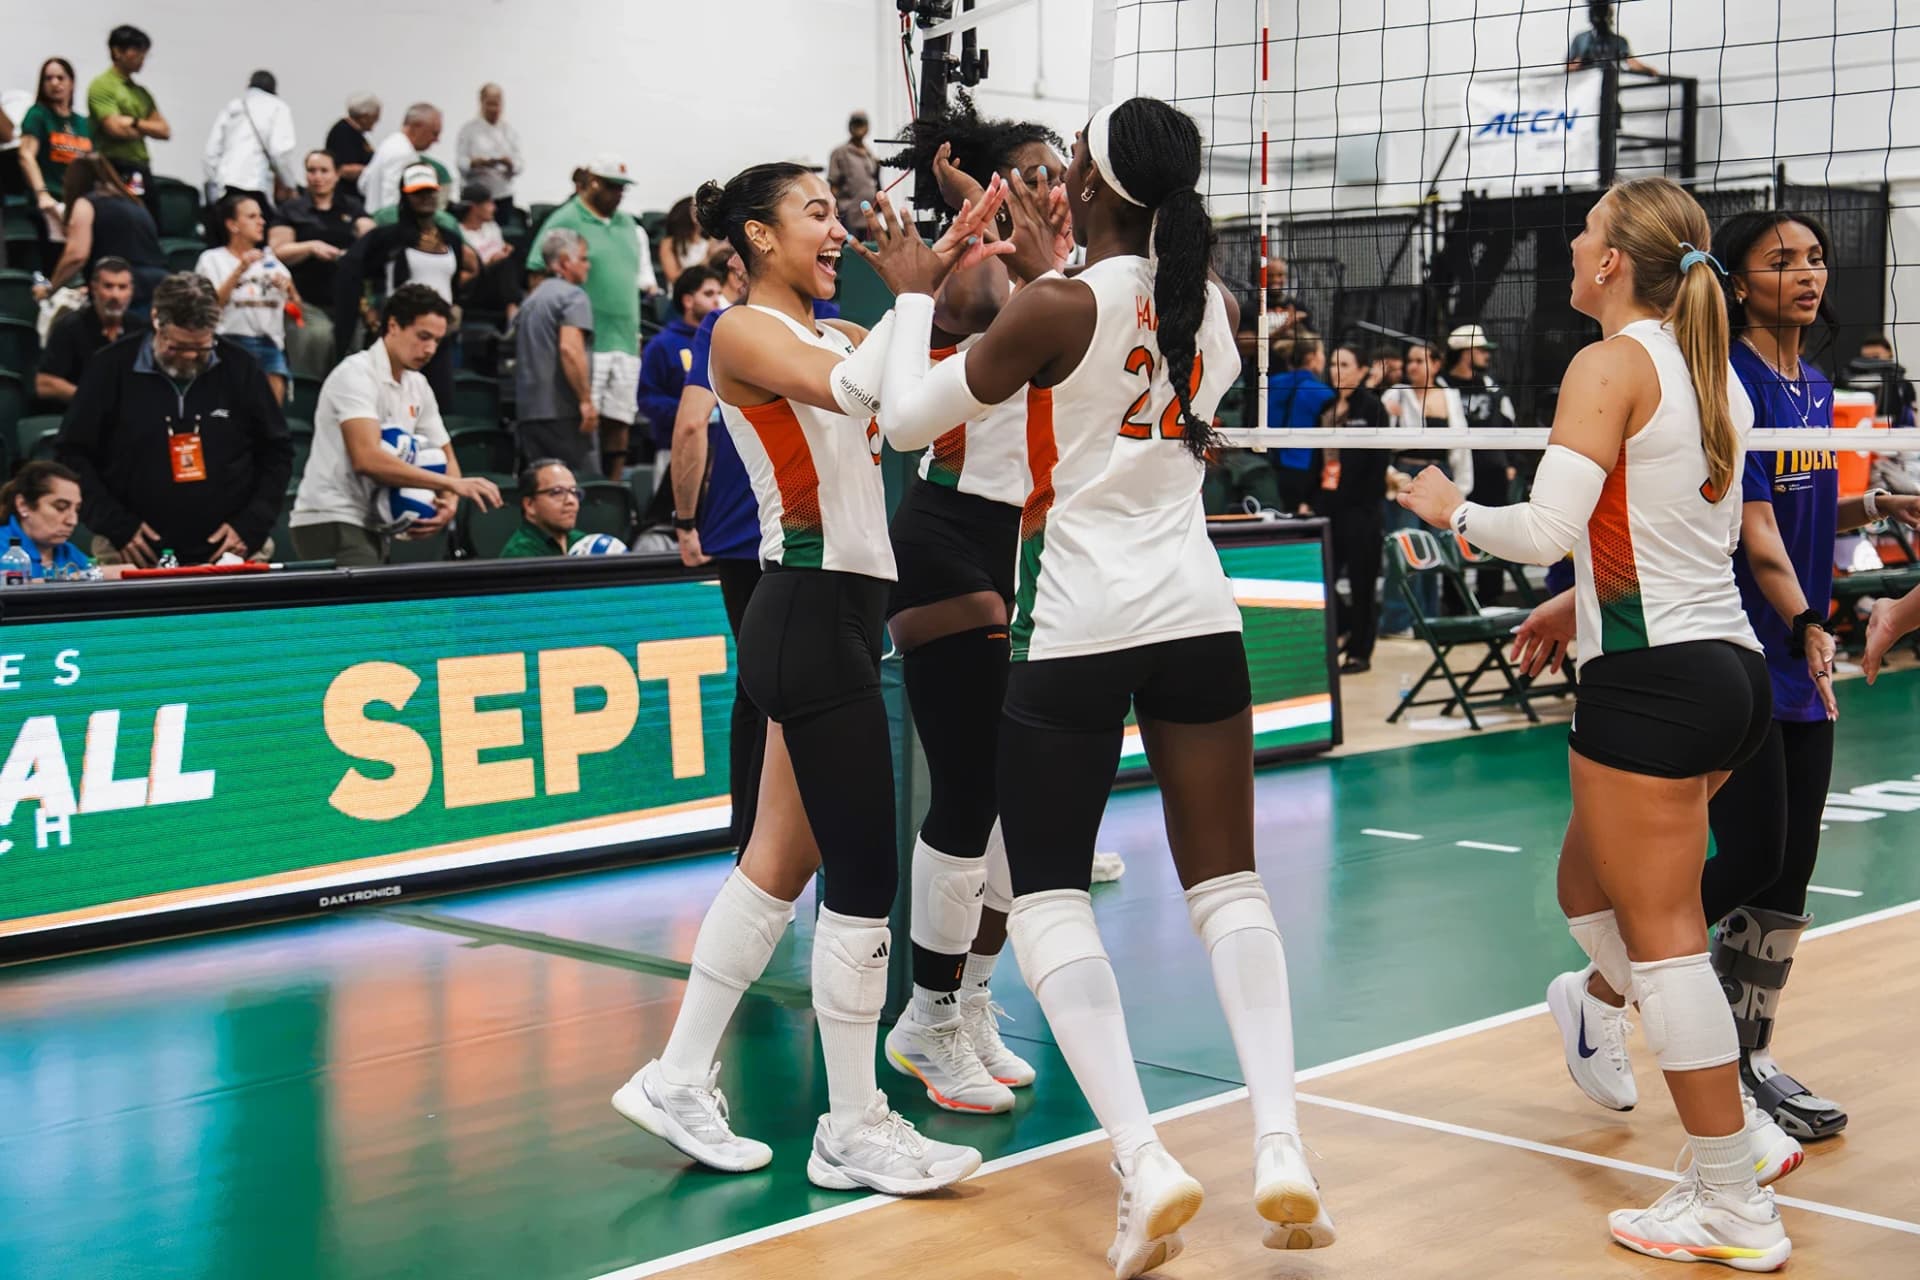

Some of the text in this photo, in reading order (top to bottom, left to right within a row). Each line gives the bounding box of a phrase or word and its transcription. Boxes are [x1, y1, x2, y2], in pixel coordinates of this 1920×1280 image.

[1475, 107, 1578, 137] ACCN
[1118, 344, 1204, 440] 22
[322, 635, 727, 822] SEPT
[319, 885, 402, 907] DAKTRONICS
